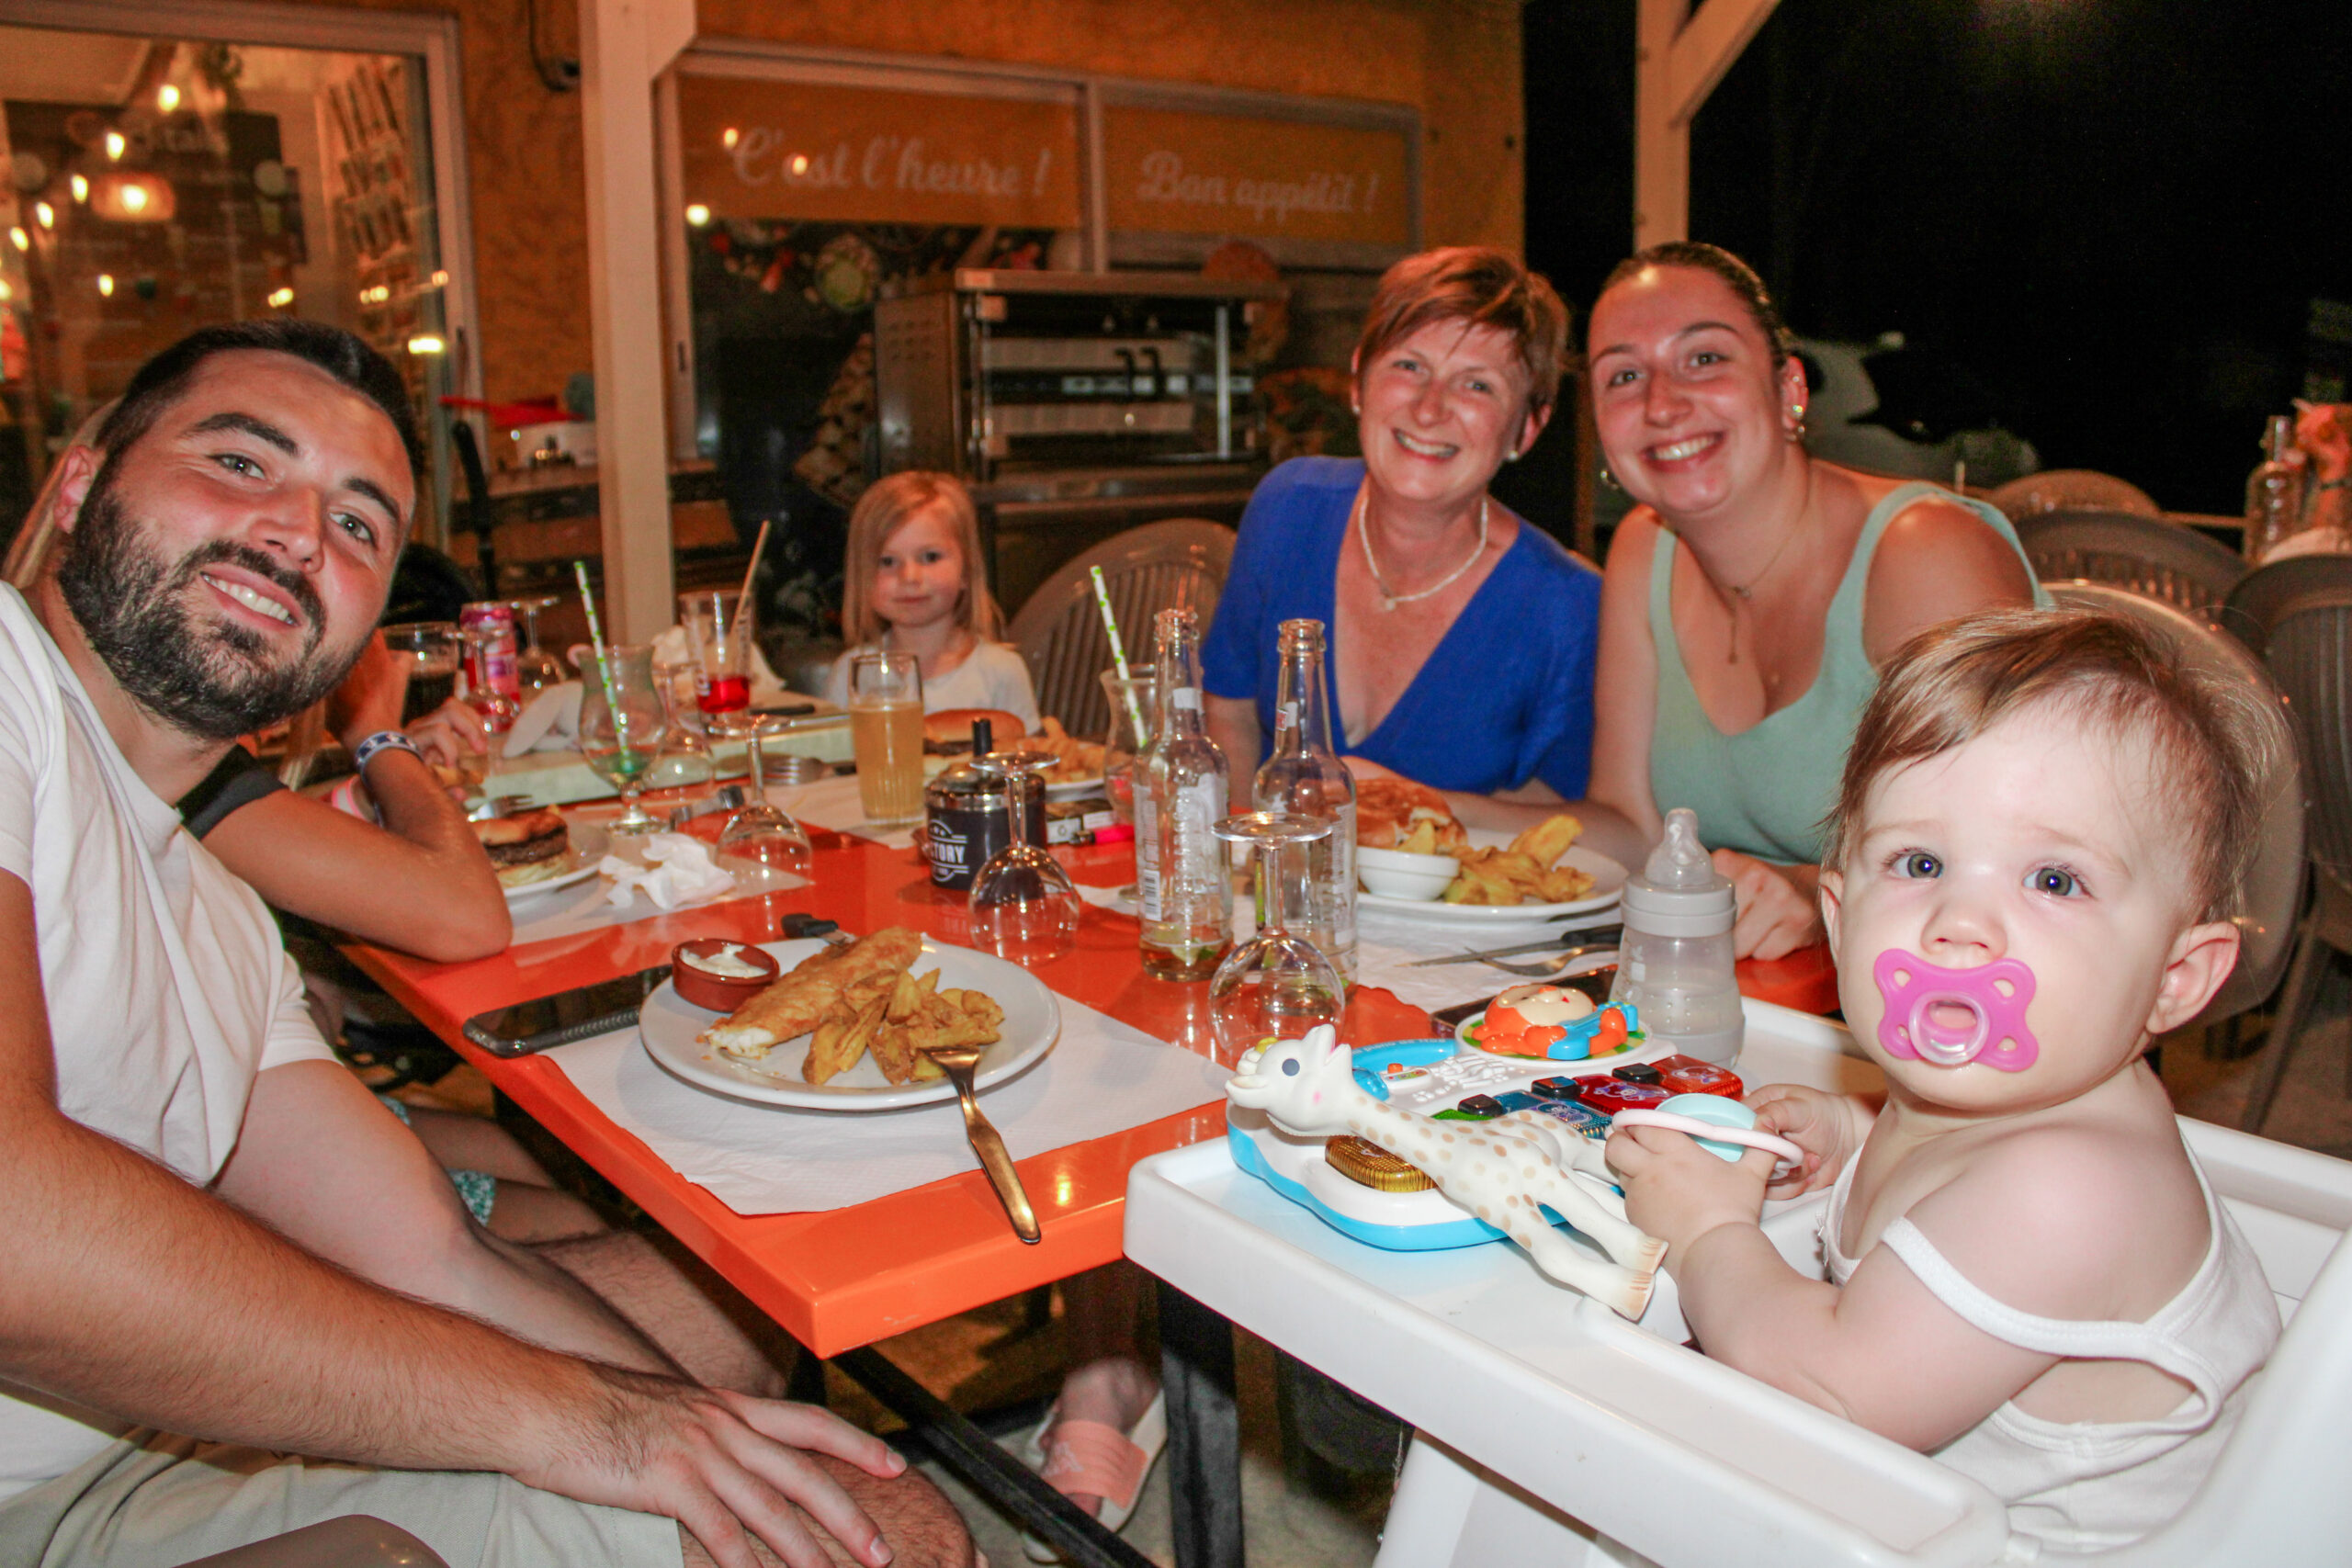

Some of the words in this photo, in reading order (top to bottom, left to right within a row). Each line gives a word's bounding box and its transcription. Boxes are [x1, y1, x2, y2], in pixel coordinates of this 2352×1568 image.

[732, 126, 851, 187] C'est
[862, 134, 1020, 196] l'heure
[1035, 147, 1052, 196] !
[1137, 151, 1227, 205] Bon
[1363, 173, 1379, 213] !
